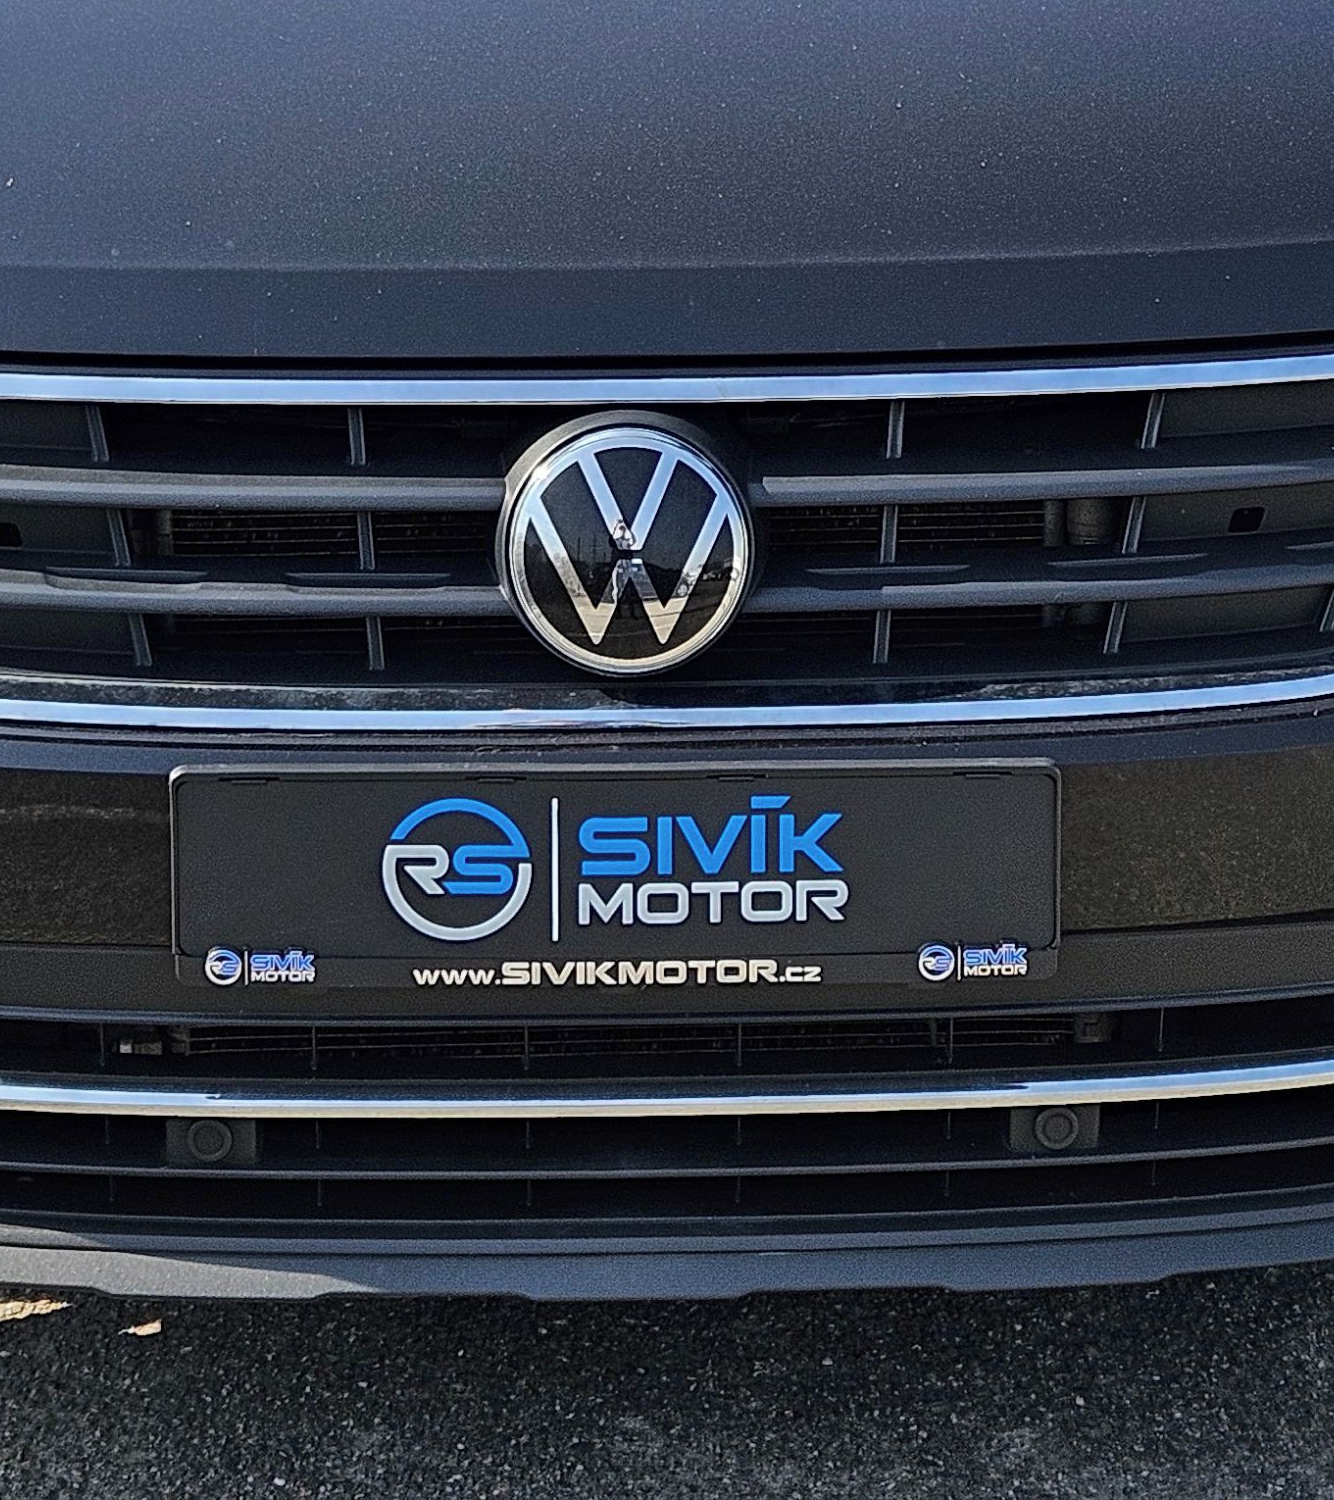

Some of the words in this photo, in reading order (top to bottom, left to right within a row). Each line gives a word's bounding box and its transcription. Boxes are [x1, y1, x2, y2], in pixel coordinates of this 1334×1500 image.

[578, 879, 849, 925] MOTOR
[251, 971, 315, 982] MOTOR
[963, 964, 1027, 977] MOTOR
